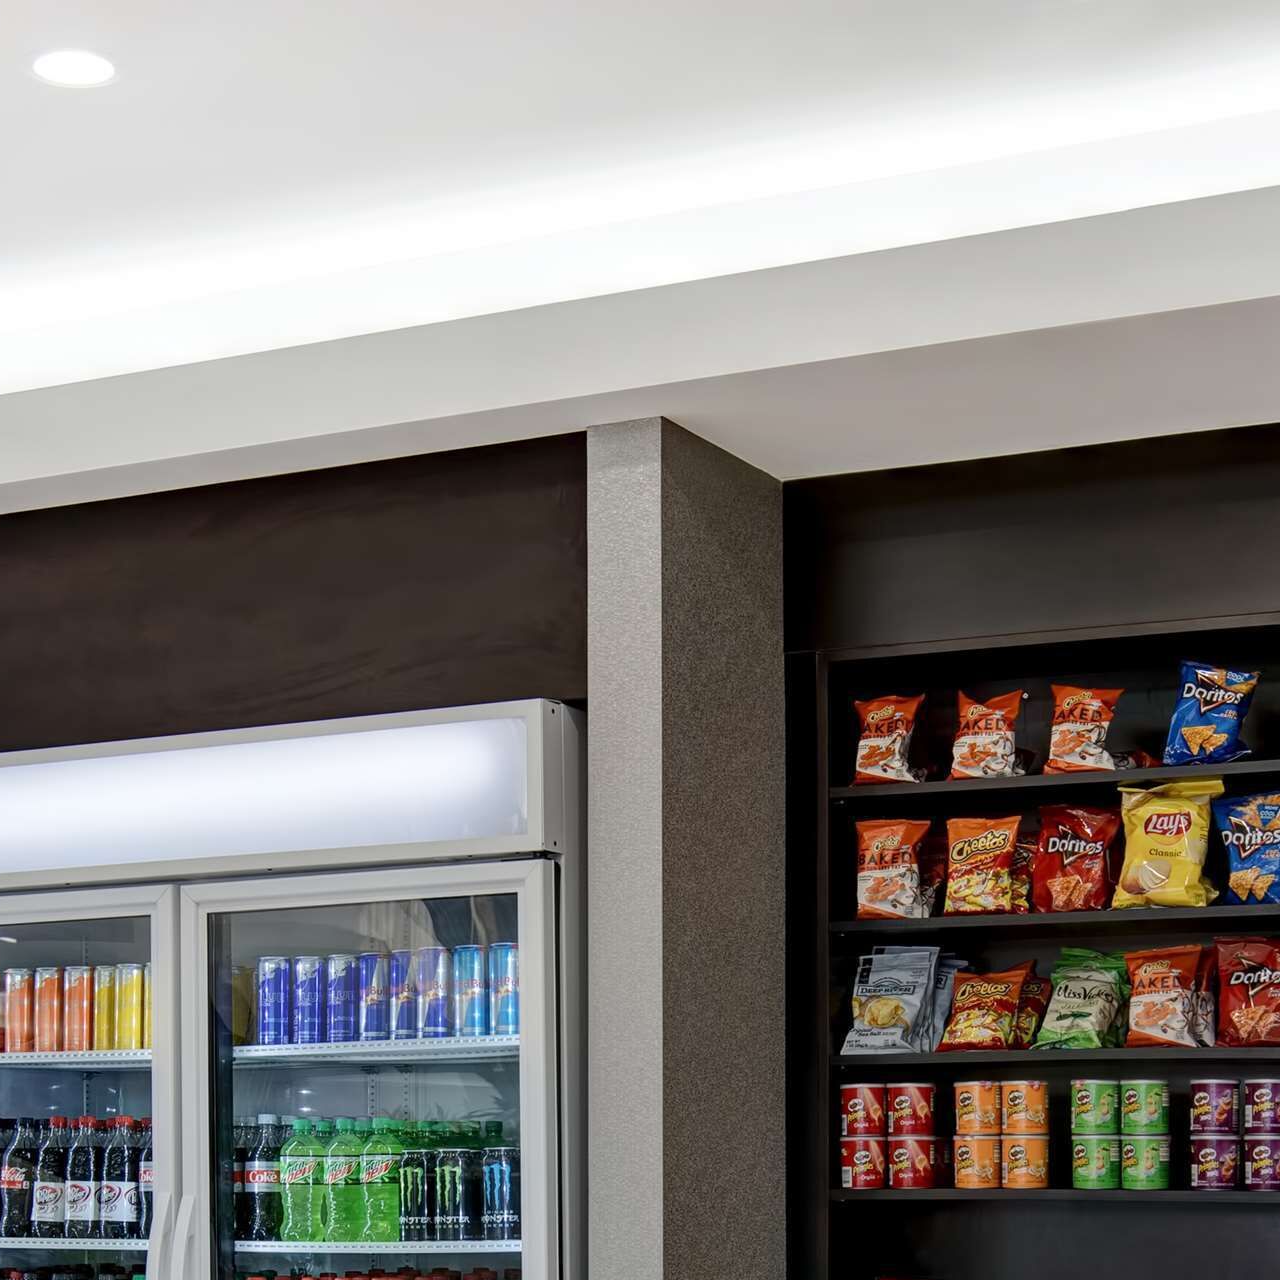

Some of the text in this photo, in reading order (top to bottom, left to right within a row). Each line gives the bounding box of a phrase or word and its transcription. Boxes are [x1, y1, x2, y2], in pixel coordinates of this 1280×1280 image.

[1183, 682, 1245, 705] Doritos
[951, 830, 1009, 862] Cheetos
[1048, 837, 1104, 854] Doritos
[249, 1171, 277, 1183] Coke
